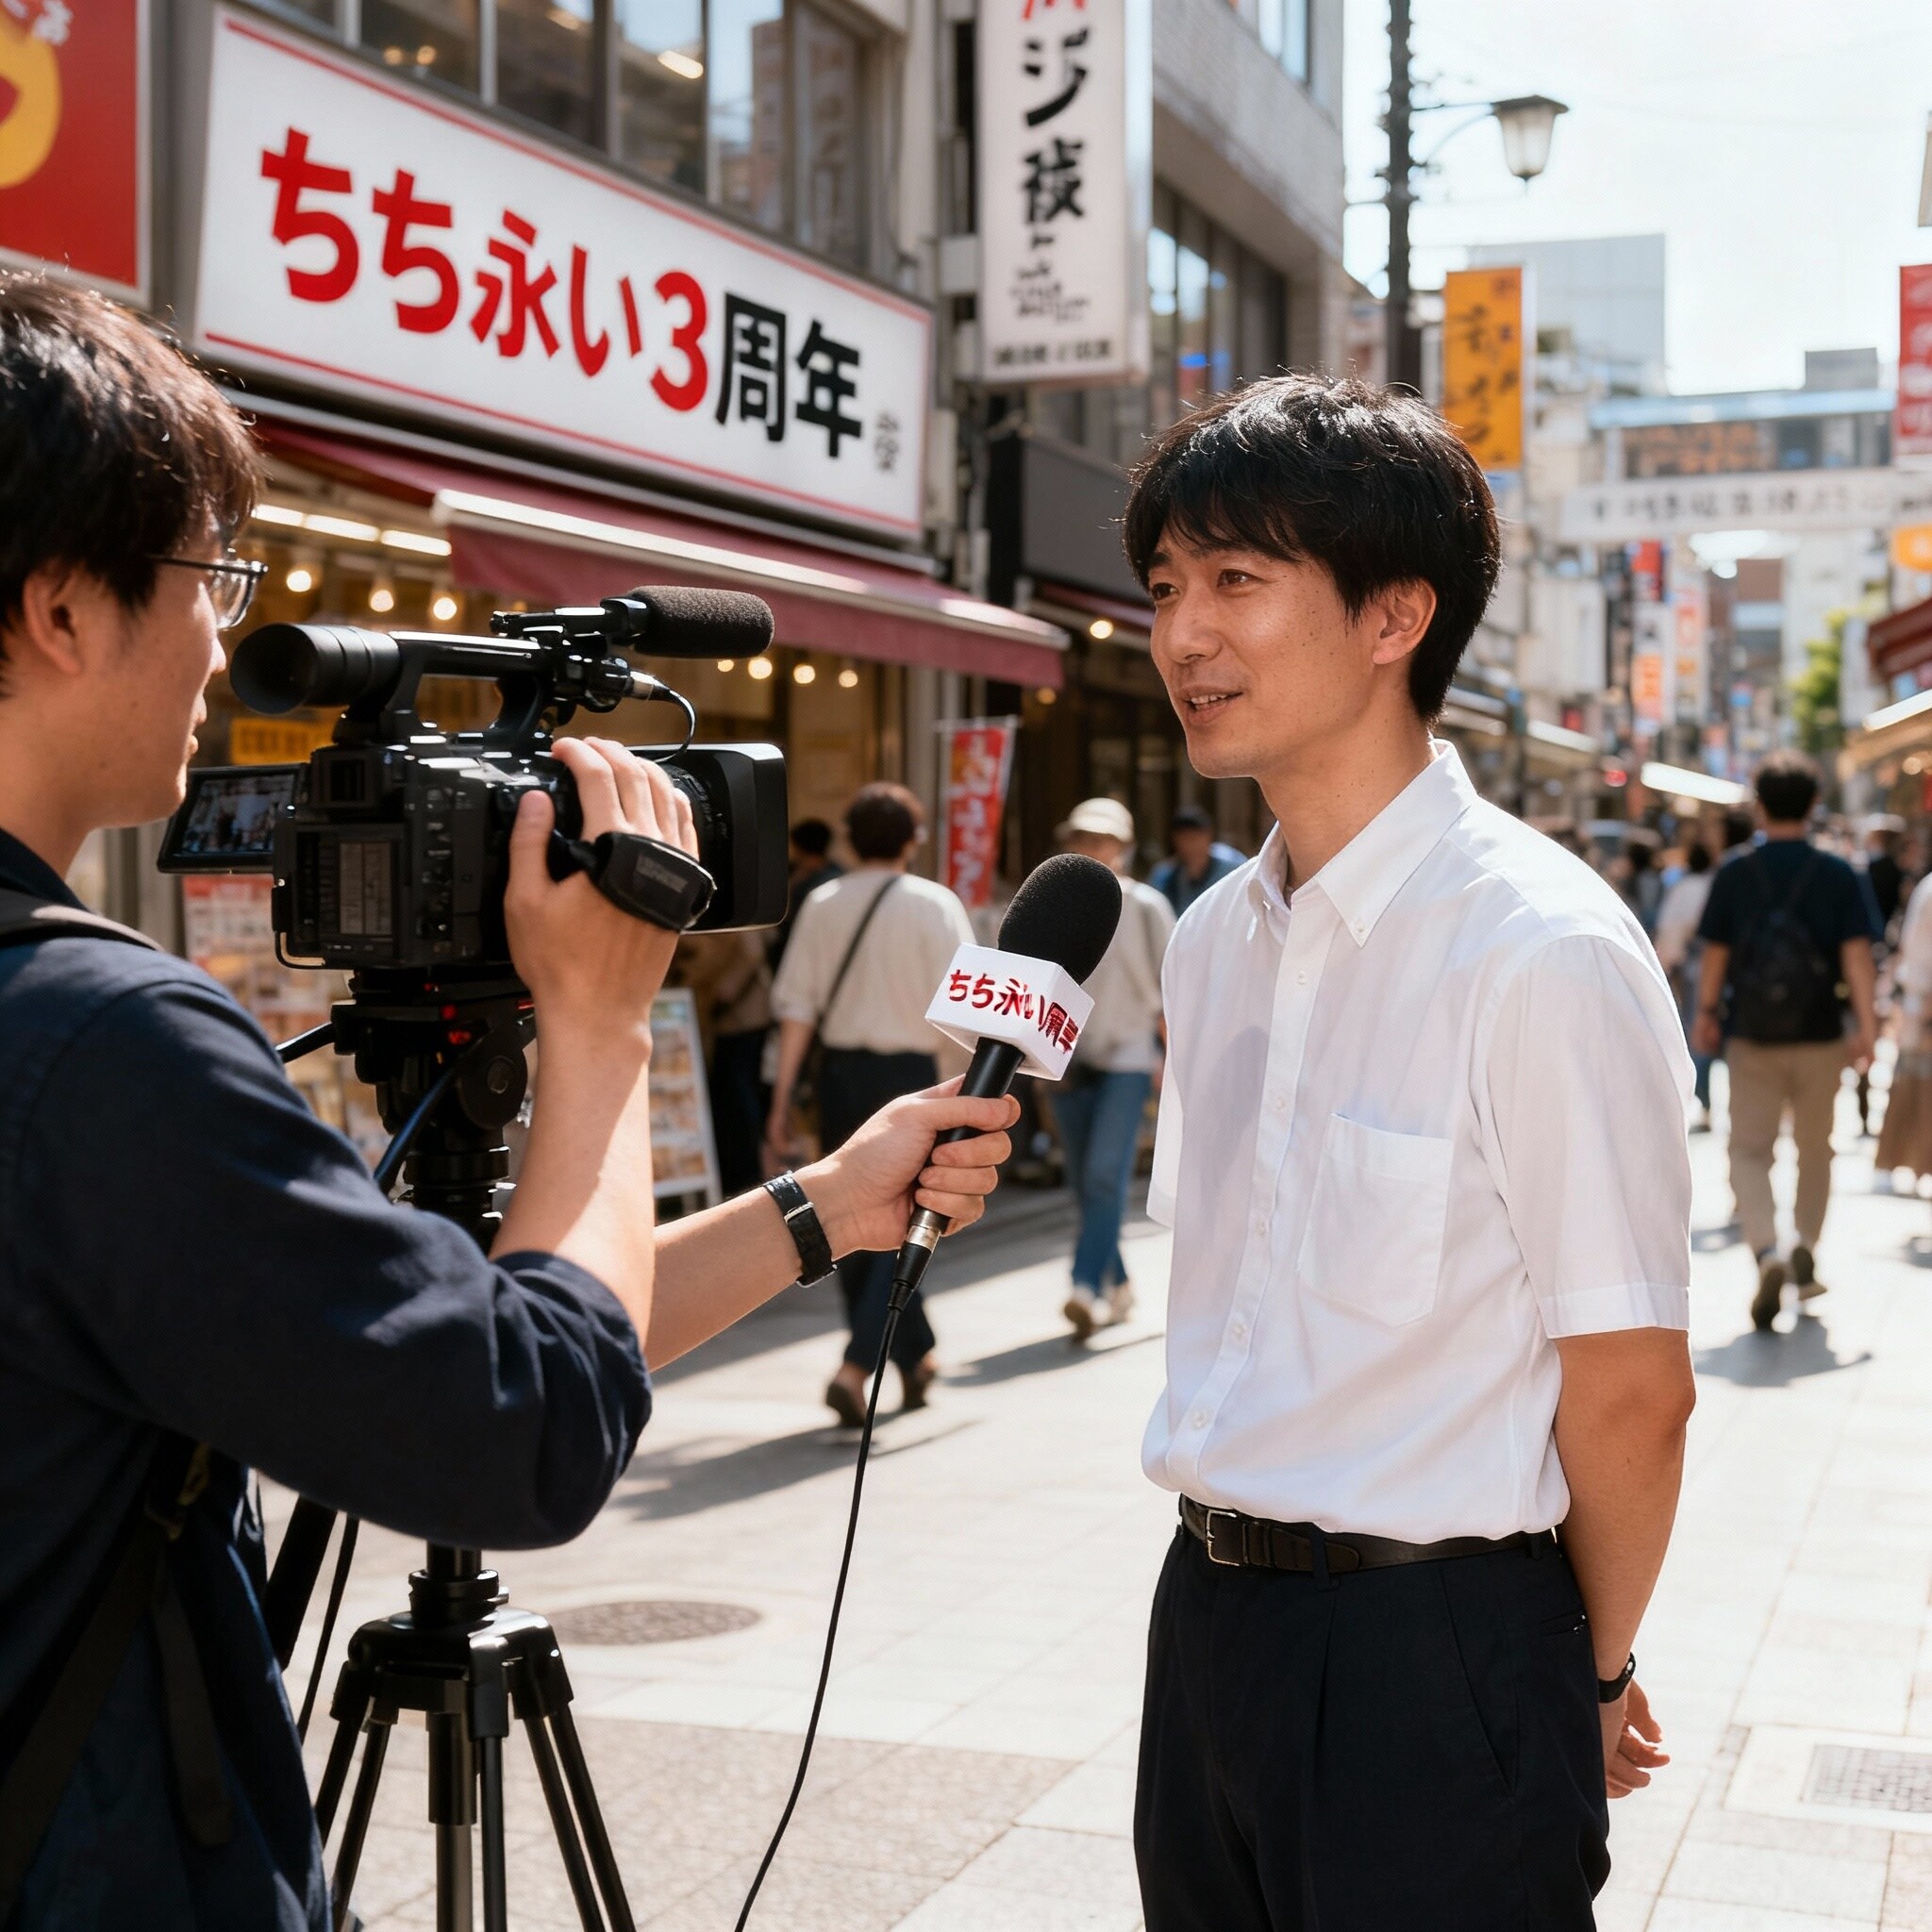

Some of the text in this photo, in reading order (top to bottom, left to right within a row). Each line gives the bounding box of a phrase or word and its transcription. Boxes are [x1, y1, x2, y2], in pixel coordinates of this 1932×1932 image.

[260, 127, 862, 458] ちち永い3周年
